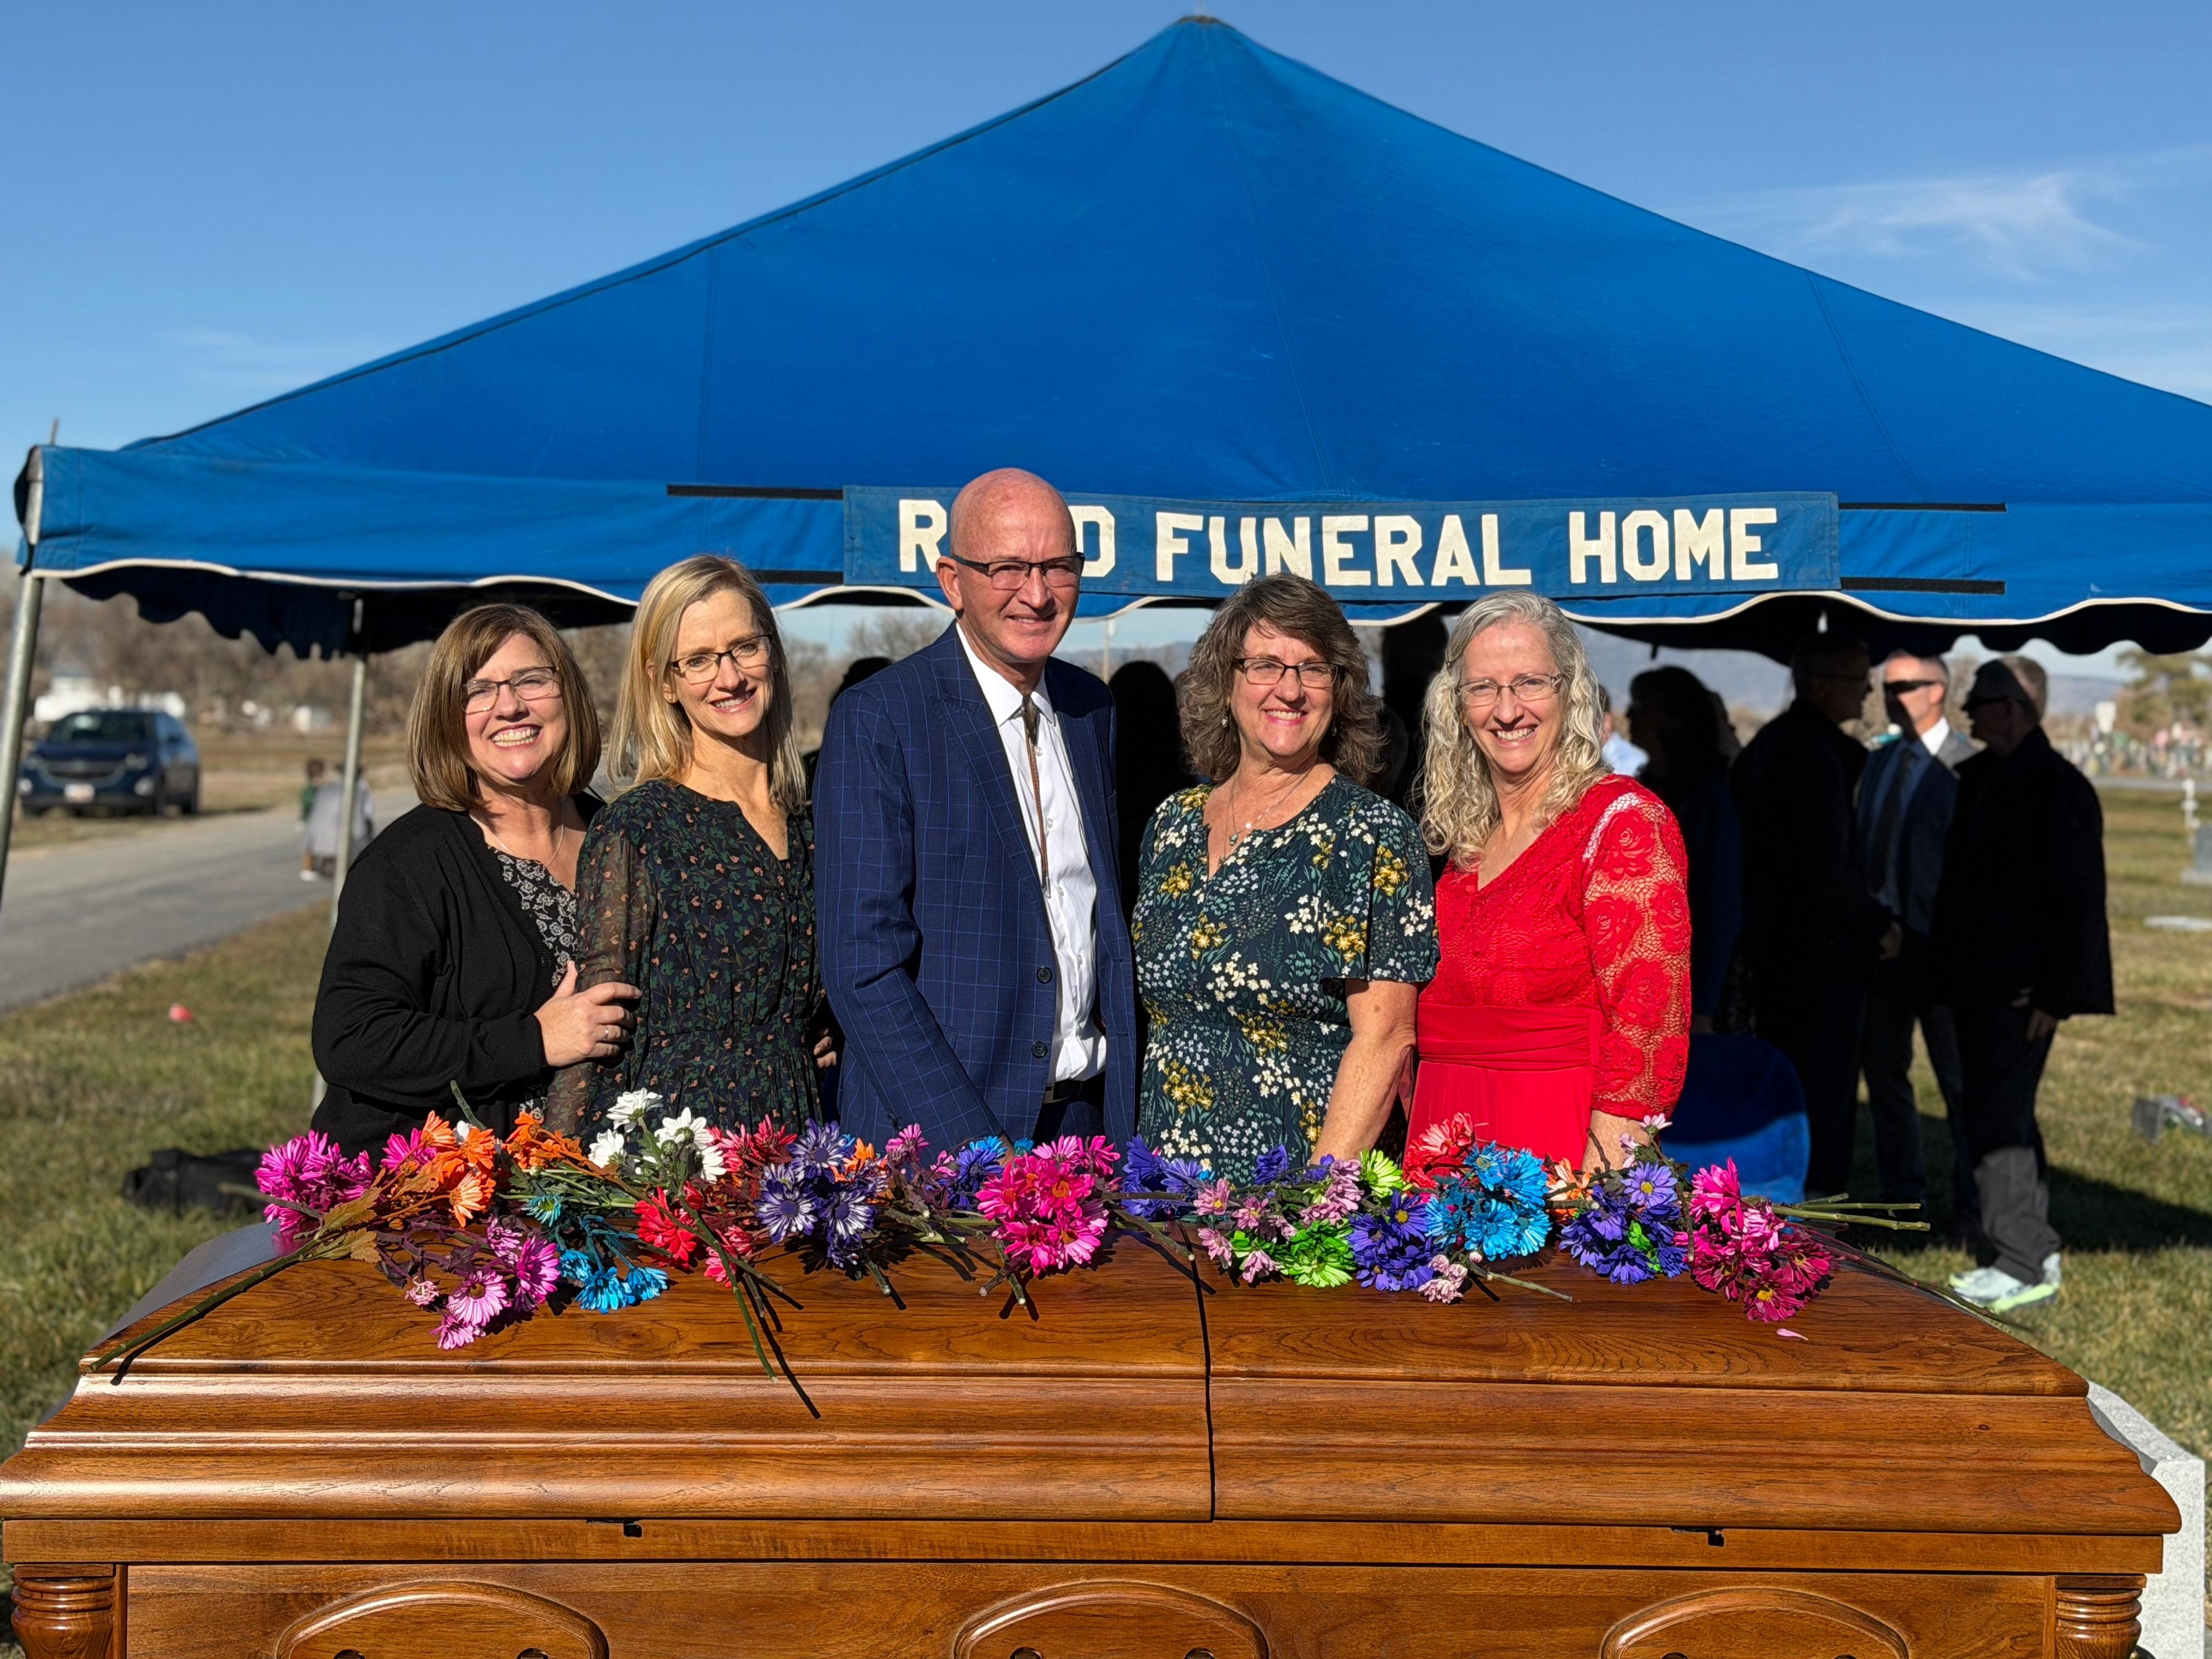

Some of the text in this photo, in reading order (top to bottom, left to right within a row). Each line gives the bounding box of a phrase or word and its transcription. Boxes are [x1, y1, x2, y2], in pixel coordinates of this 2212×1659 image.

[899, 499, 1779, 586] RD FUNERAL HOME
